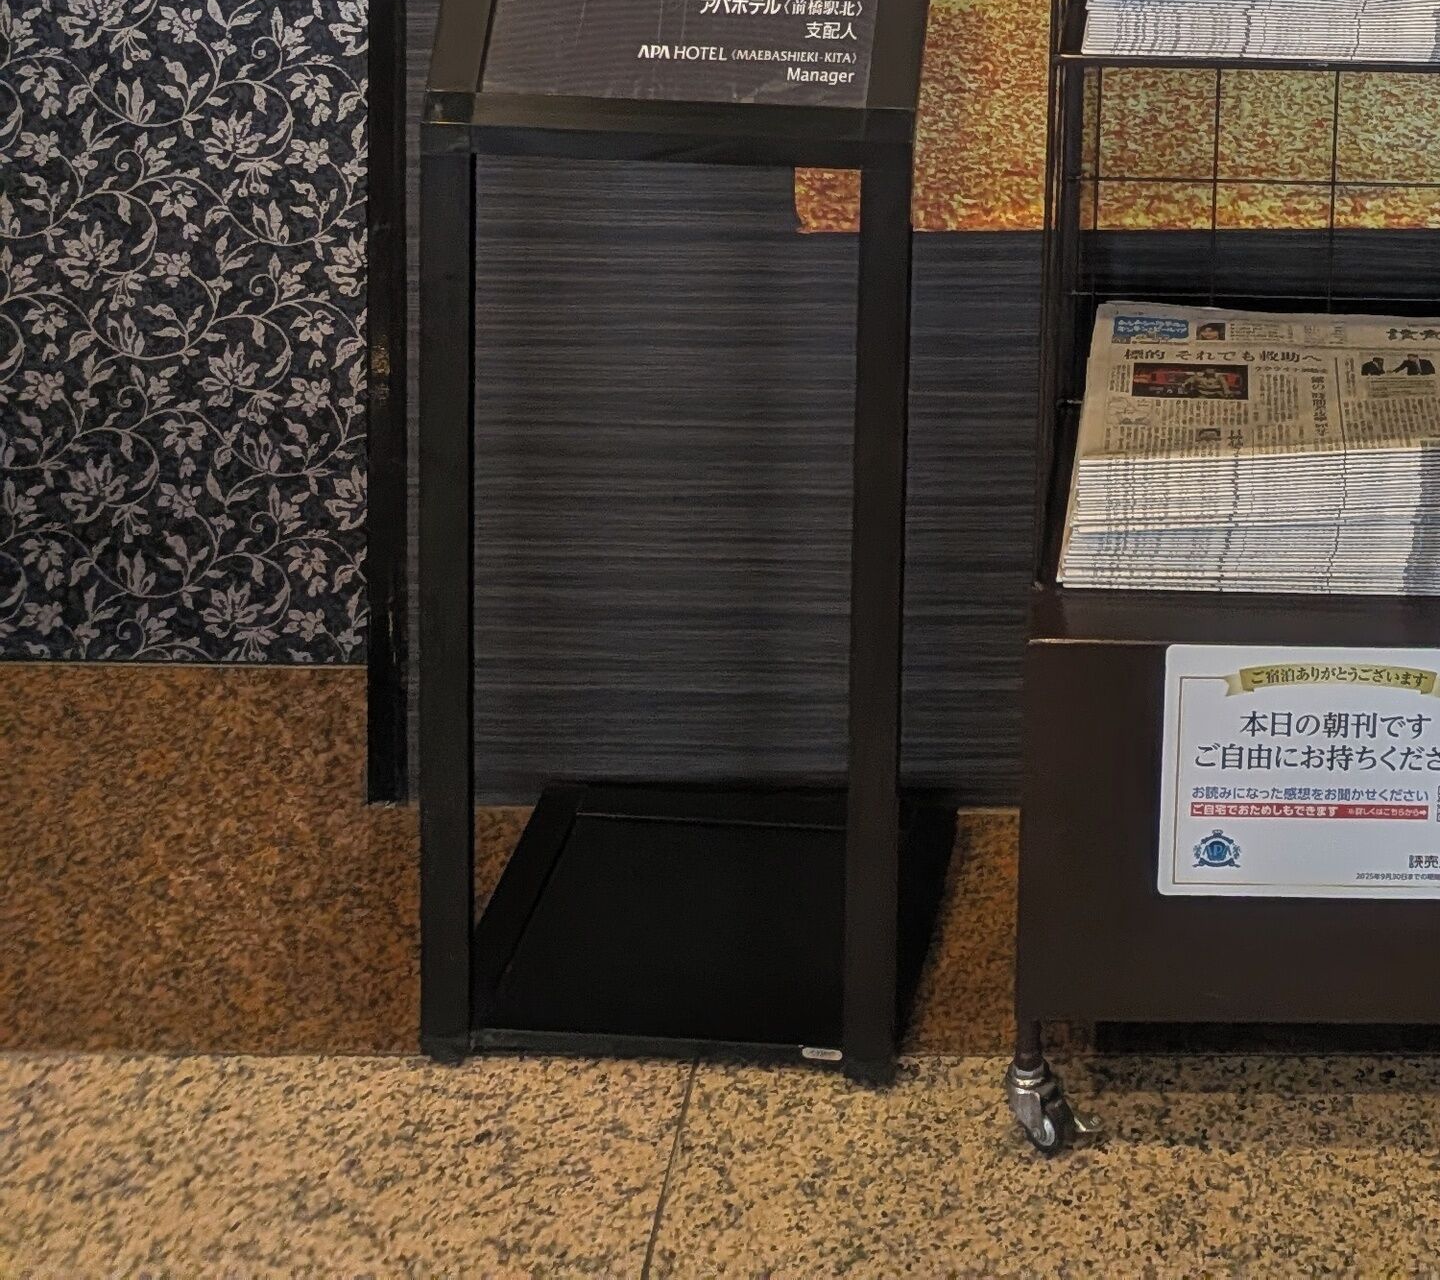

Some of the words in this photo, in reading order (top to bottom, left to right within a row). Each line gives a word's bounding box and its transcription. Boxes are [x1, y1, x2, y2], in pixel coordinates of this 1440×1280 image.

[804, 21, 858, 41] 支配人
[672, 45, 728, 62] HOTEL
[786, 67, 856, 86] Manager
[1123, 347, 1166, 361] 標的
[1174, 349, 1323, 363] それでも救助へ
[1250, 666, 1429, 688] ご宿泊ありがとうございます
[1239, 710, 1433, 739] 本日の朝刊です
[1191, 786, 1430, 802] お読みになった感想をお聞かせください
[1191, 804, 1340, 818] ご自宅でおためしもできます
